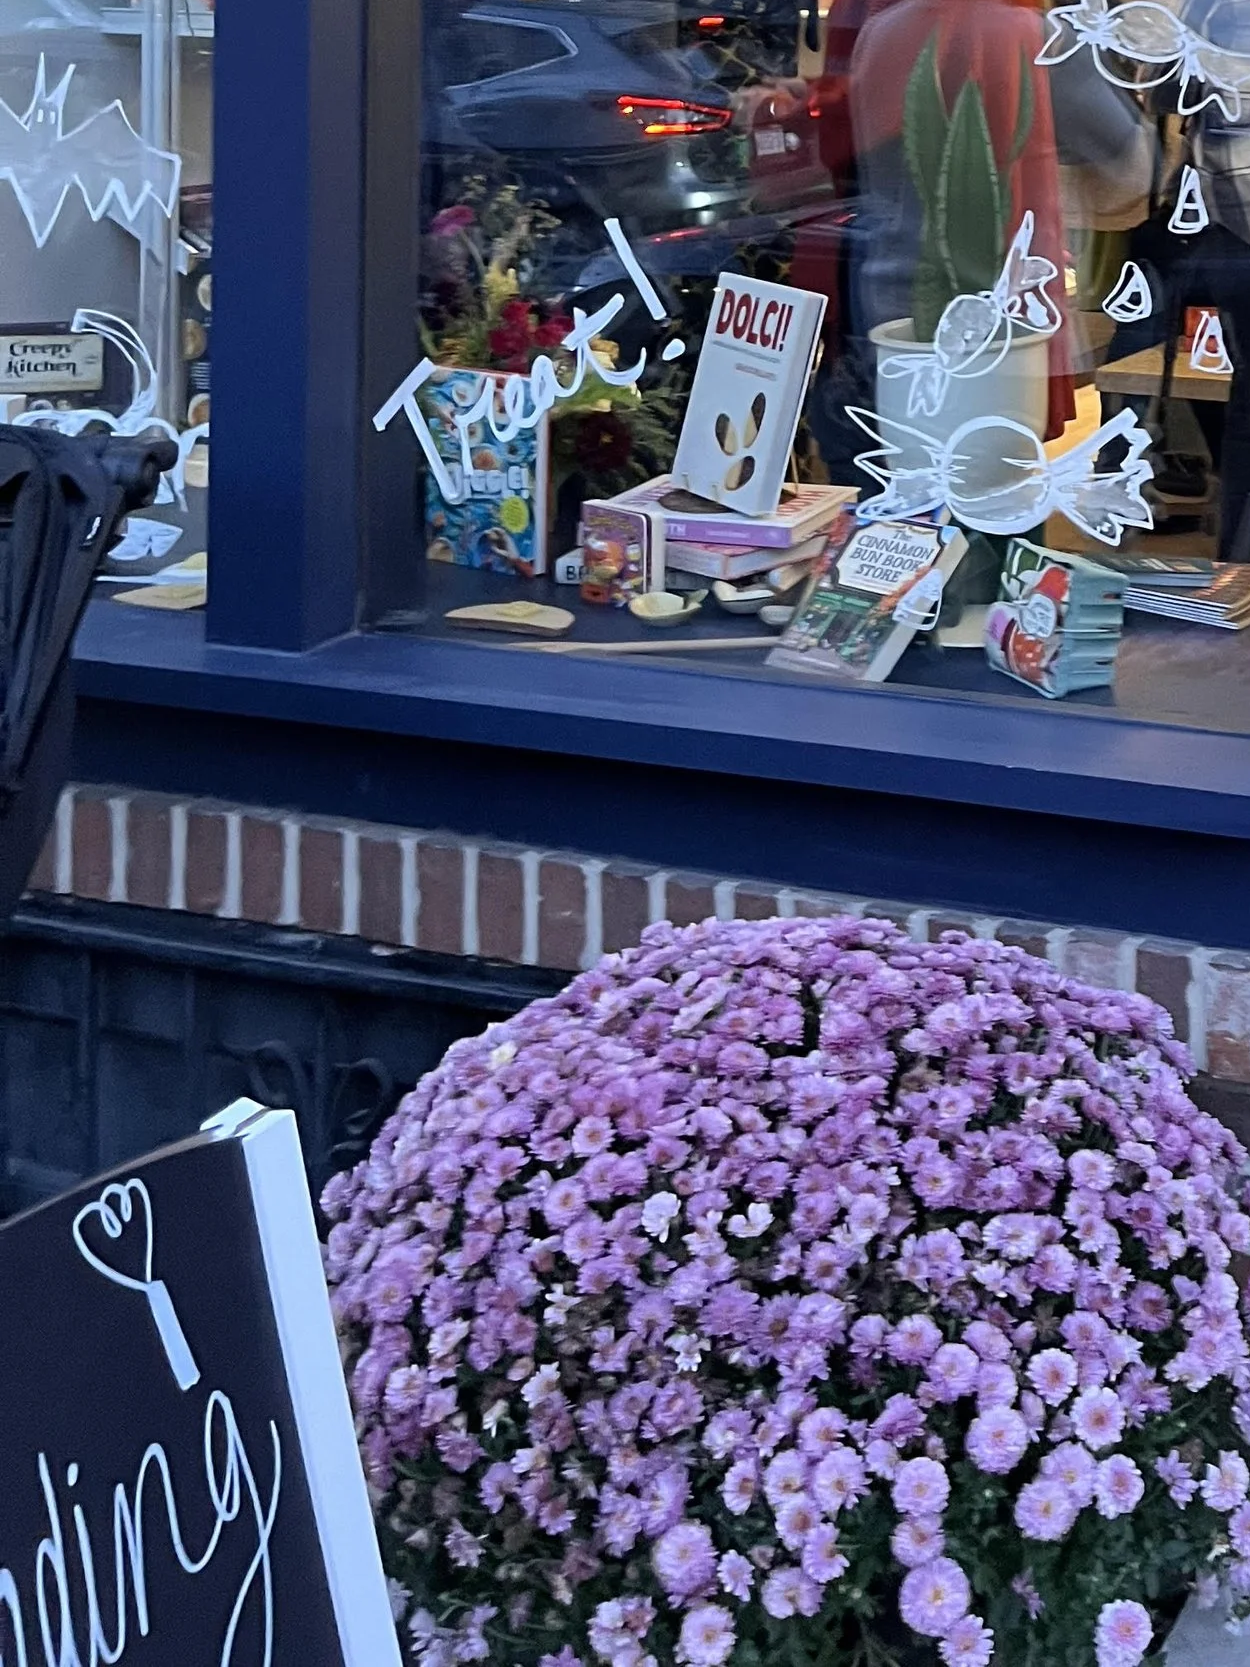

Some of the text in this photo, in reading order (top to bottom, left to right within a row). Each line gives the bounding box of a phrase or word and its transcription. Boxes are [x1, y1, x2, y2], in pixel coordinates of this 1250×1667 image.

[715, 288, 794, 352] DOLCI!
[6, 359, 77, 378] Kitchen
[373, 217, 686, 505] Treat!
[849, 547, 925, 572] BUN BOOK
[857, 535, 935, 560] CINNAMON
[855, 563, 902, 583] STORE
